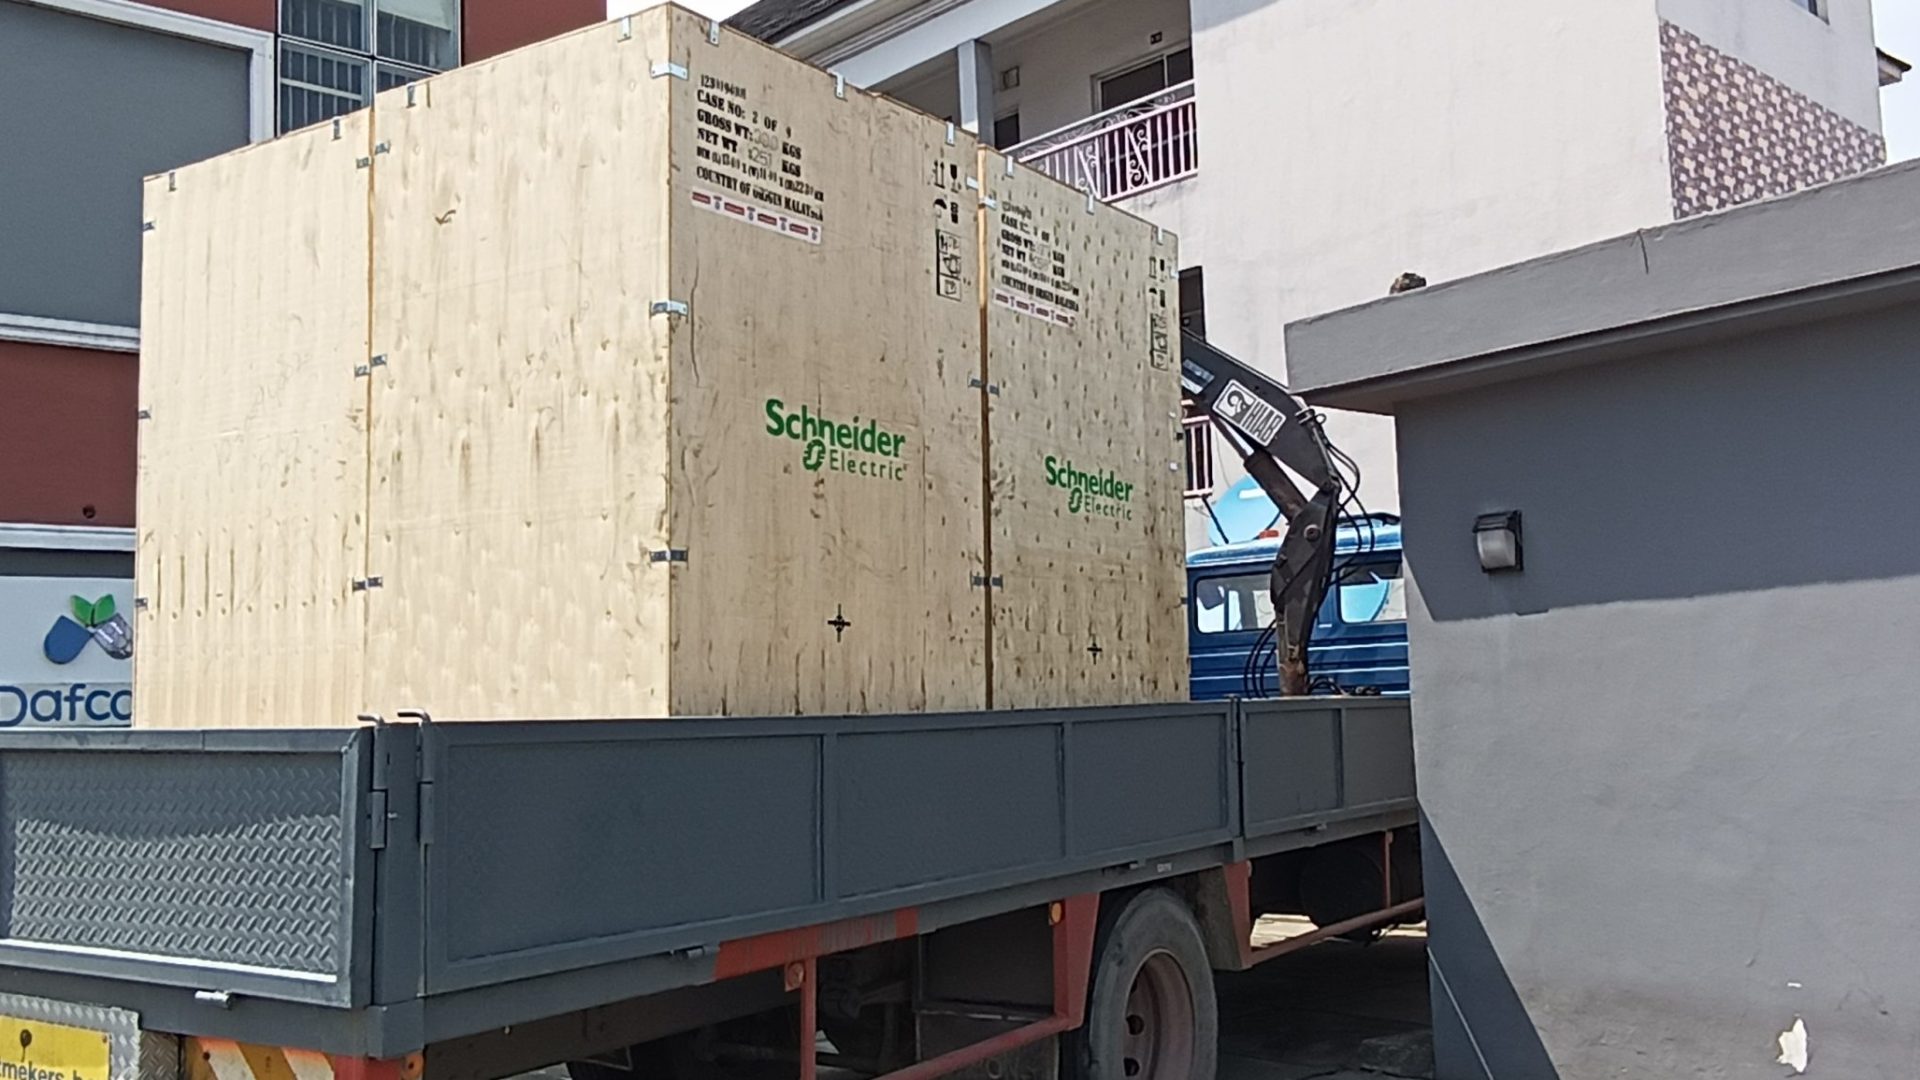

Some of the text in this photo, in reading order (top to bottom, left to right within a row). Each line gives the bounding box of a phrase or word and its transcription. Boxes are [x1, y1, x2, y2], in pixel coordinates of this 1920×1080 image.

[697, 89, 725, 112] CASE
[727, 101, 746, 119] NO:
[752, 111, 758, 124] 2
[764, 116, 778, 131] OF
[697, 108, 732, 133] GROSS
[734, 122, 753, 141] WT:
[782, 141, 802, 160] KGS
[697, 127, 719, 145] NET
[721, 136, 738, 153] WT
[782, 159, 802, 178] KGS
[697, 166, 738, 191] COUNTRY
[740, 181, 751, 196] OF
[766, 399, 906, 458] Schneider
[1240, 401, 1284, 444] HIAB
[829, 449, 905, 481] Electric
[1045, 456, 1133, 502] Schneider
[1085, 495, 1132, 521] Electric
